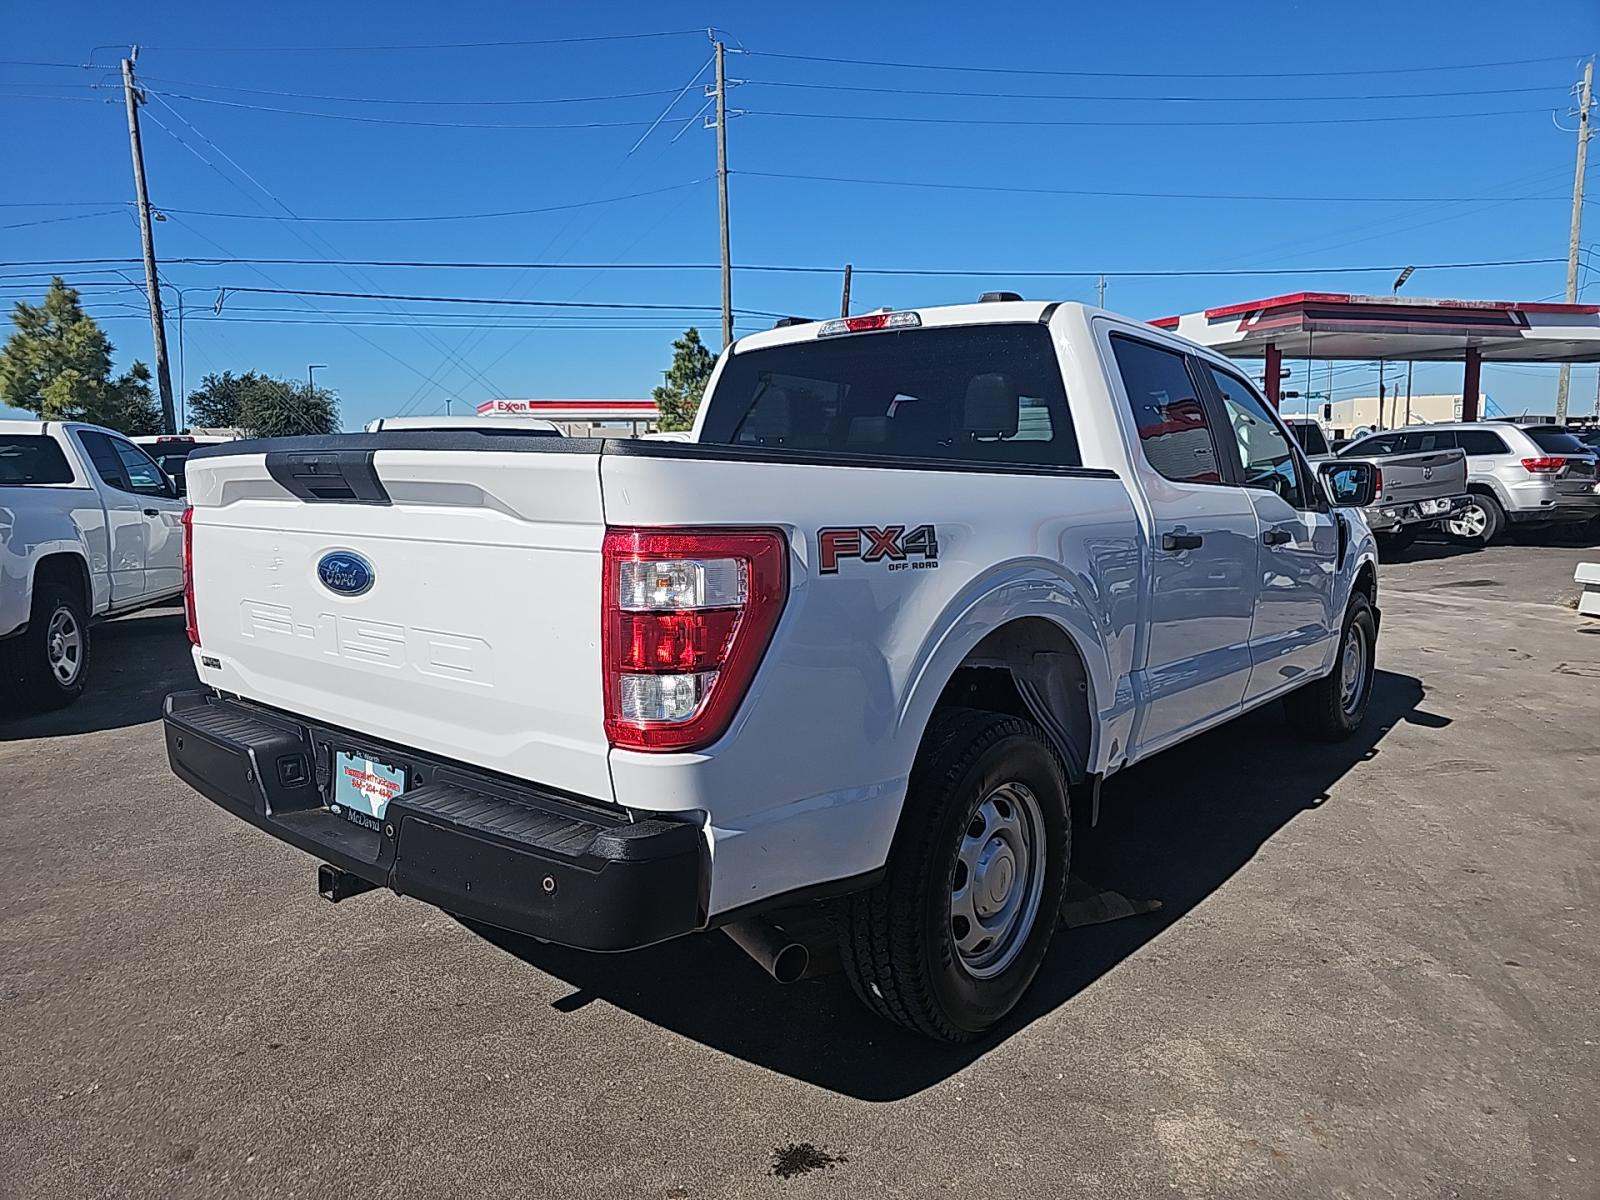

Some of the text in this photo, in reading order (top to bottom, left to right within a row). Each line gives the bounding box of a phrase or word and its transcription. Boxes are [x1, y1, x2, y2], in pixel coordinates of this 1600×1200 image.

[498, 401, 527, 413] Exxon
[817, 525, 938, 575] FX4
[888, 561, 939, 571] OFF ROAD
[240, 598, 495, 688] F-150
[347, 809, 380, 832] McDavid
